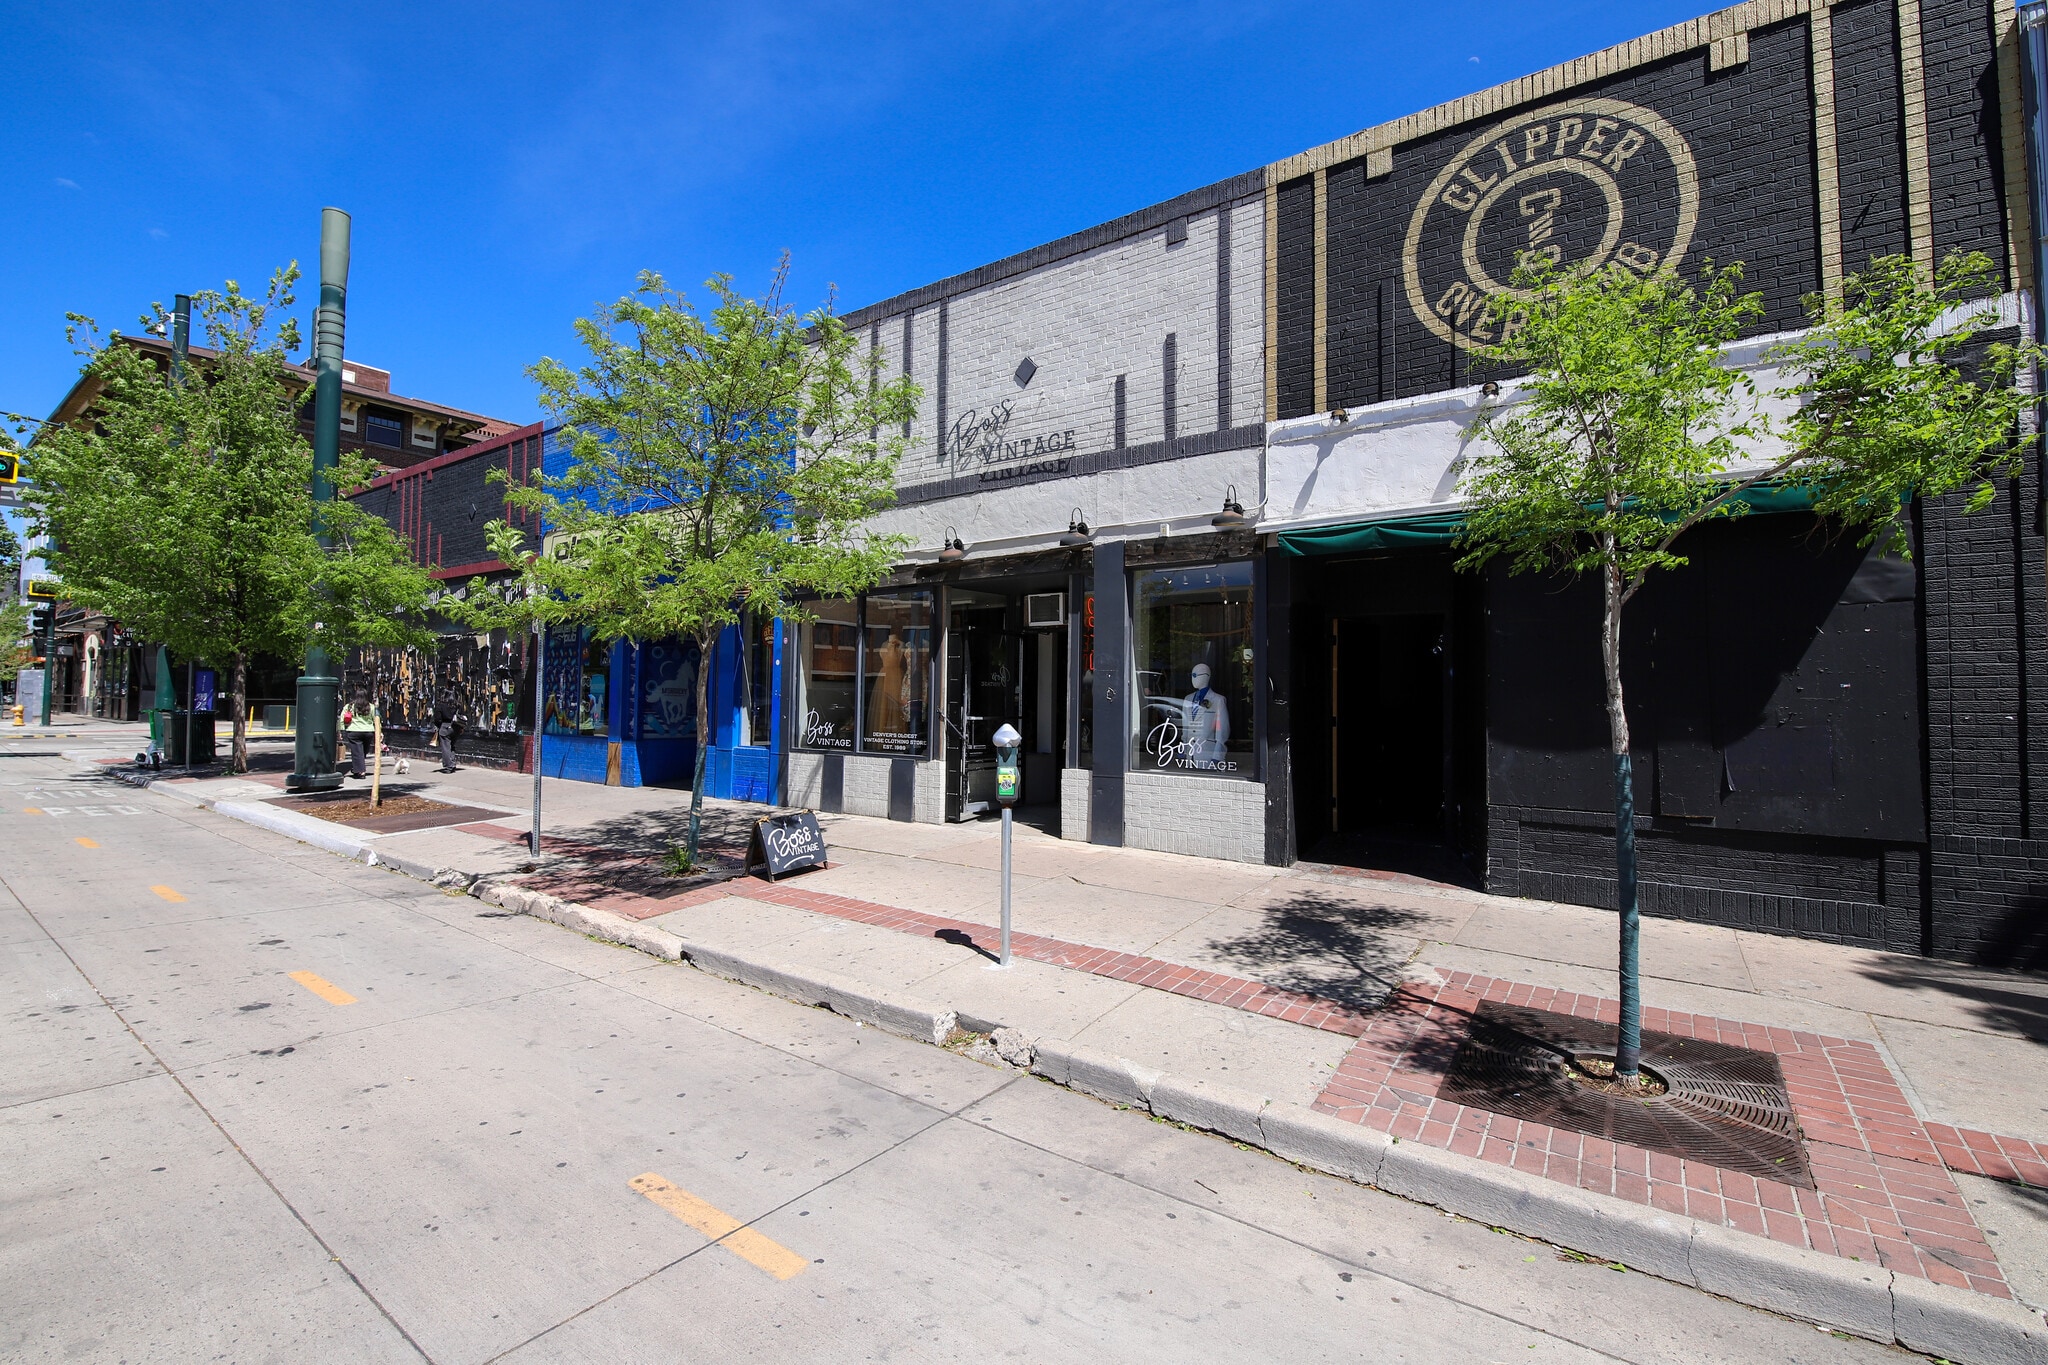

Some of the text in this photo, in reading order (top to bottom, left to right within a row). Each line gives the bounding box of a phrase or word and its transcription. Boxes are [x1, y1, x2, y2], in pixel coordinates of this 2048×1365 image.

[1441, 117, 1646, 212] CLIPPER
[945, 398, 1018, 458] Boss
[980, 429, 1077, 465] VINTAGE
[801, 707, 835, 745] Boss
[816, 737, 851, 747] VINTAGE
[872, 731, 897, 739] DENVER'S
[1146, 717, 1207, 767] Boss
[1175, 758, 1238, 772] VINTAGE
[767, 826, 812, 857] Boss
[788, 842, 820, 856] VINTAGE
